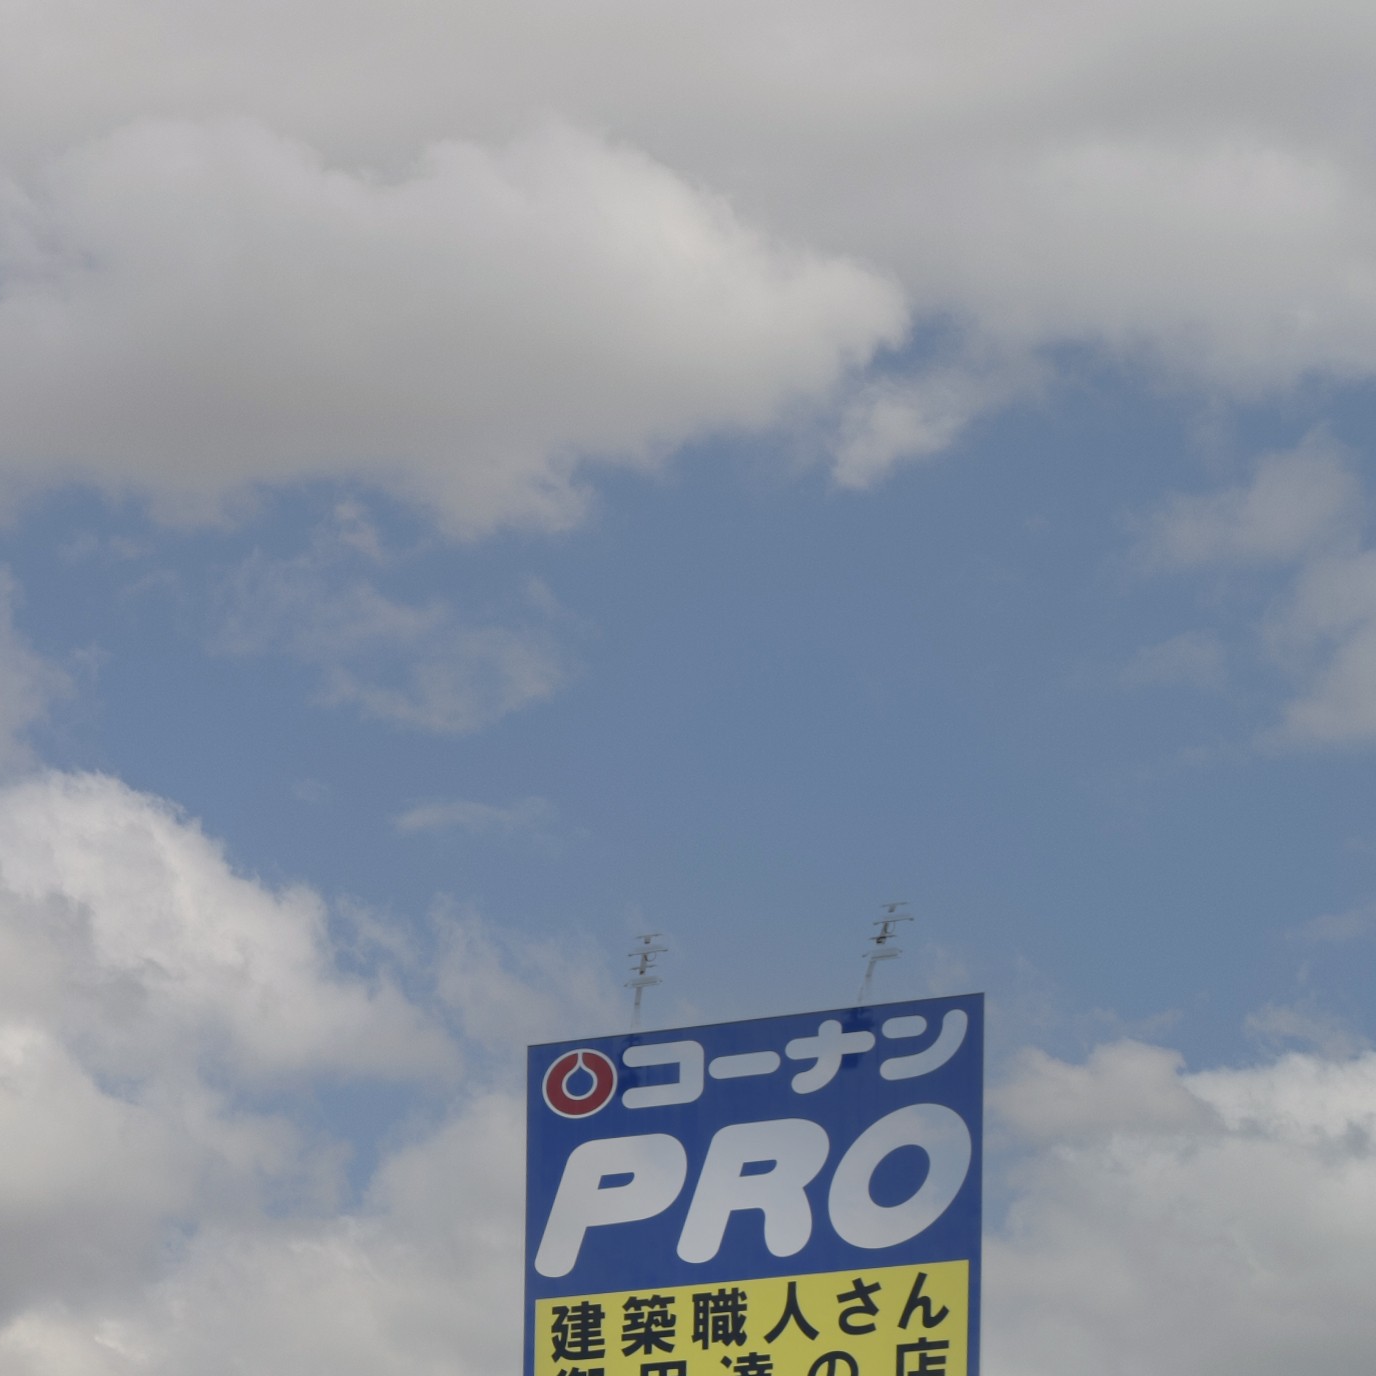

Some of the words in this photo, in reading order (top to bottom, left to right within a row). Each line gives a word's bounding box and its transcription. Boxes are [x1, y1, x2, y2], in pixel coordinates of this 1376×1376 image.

[621, 1008, 968, 1109] コーナン
[534, 1103, 972, 1278] PRO
[550, 1271, 949, 1364] 建築職人さん
